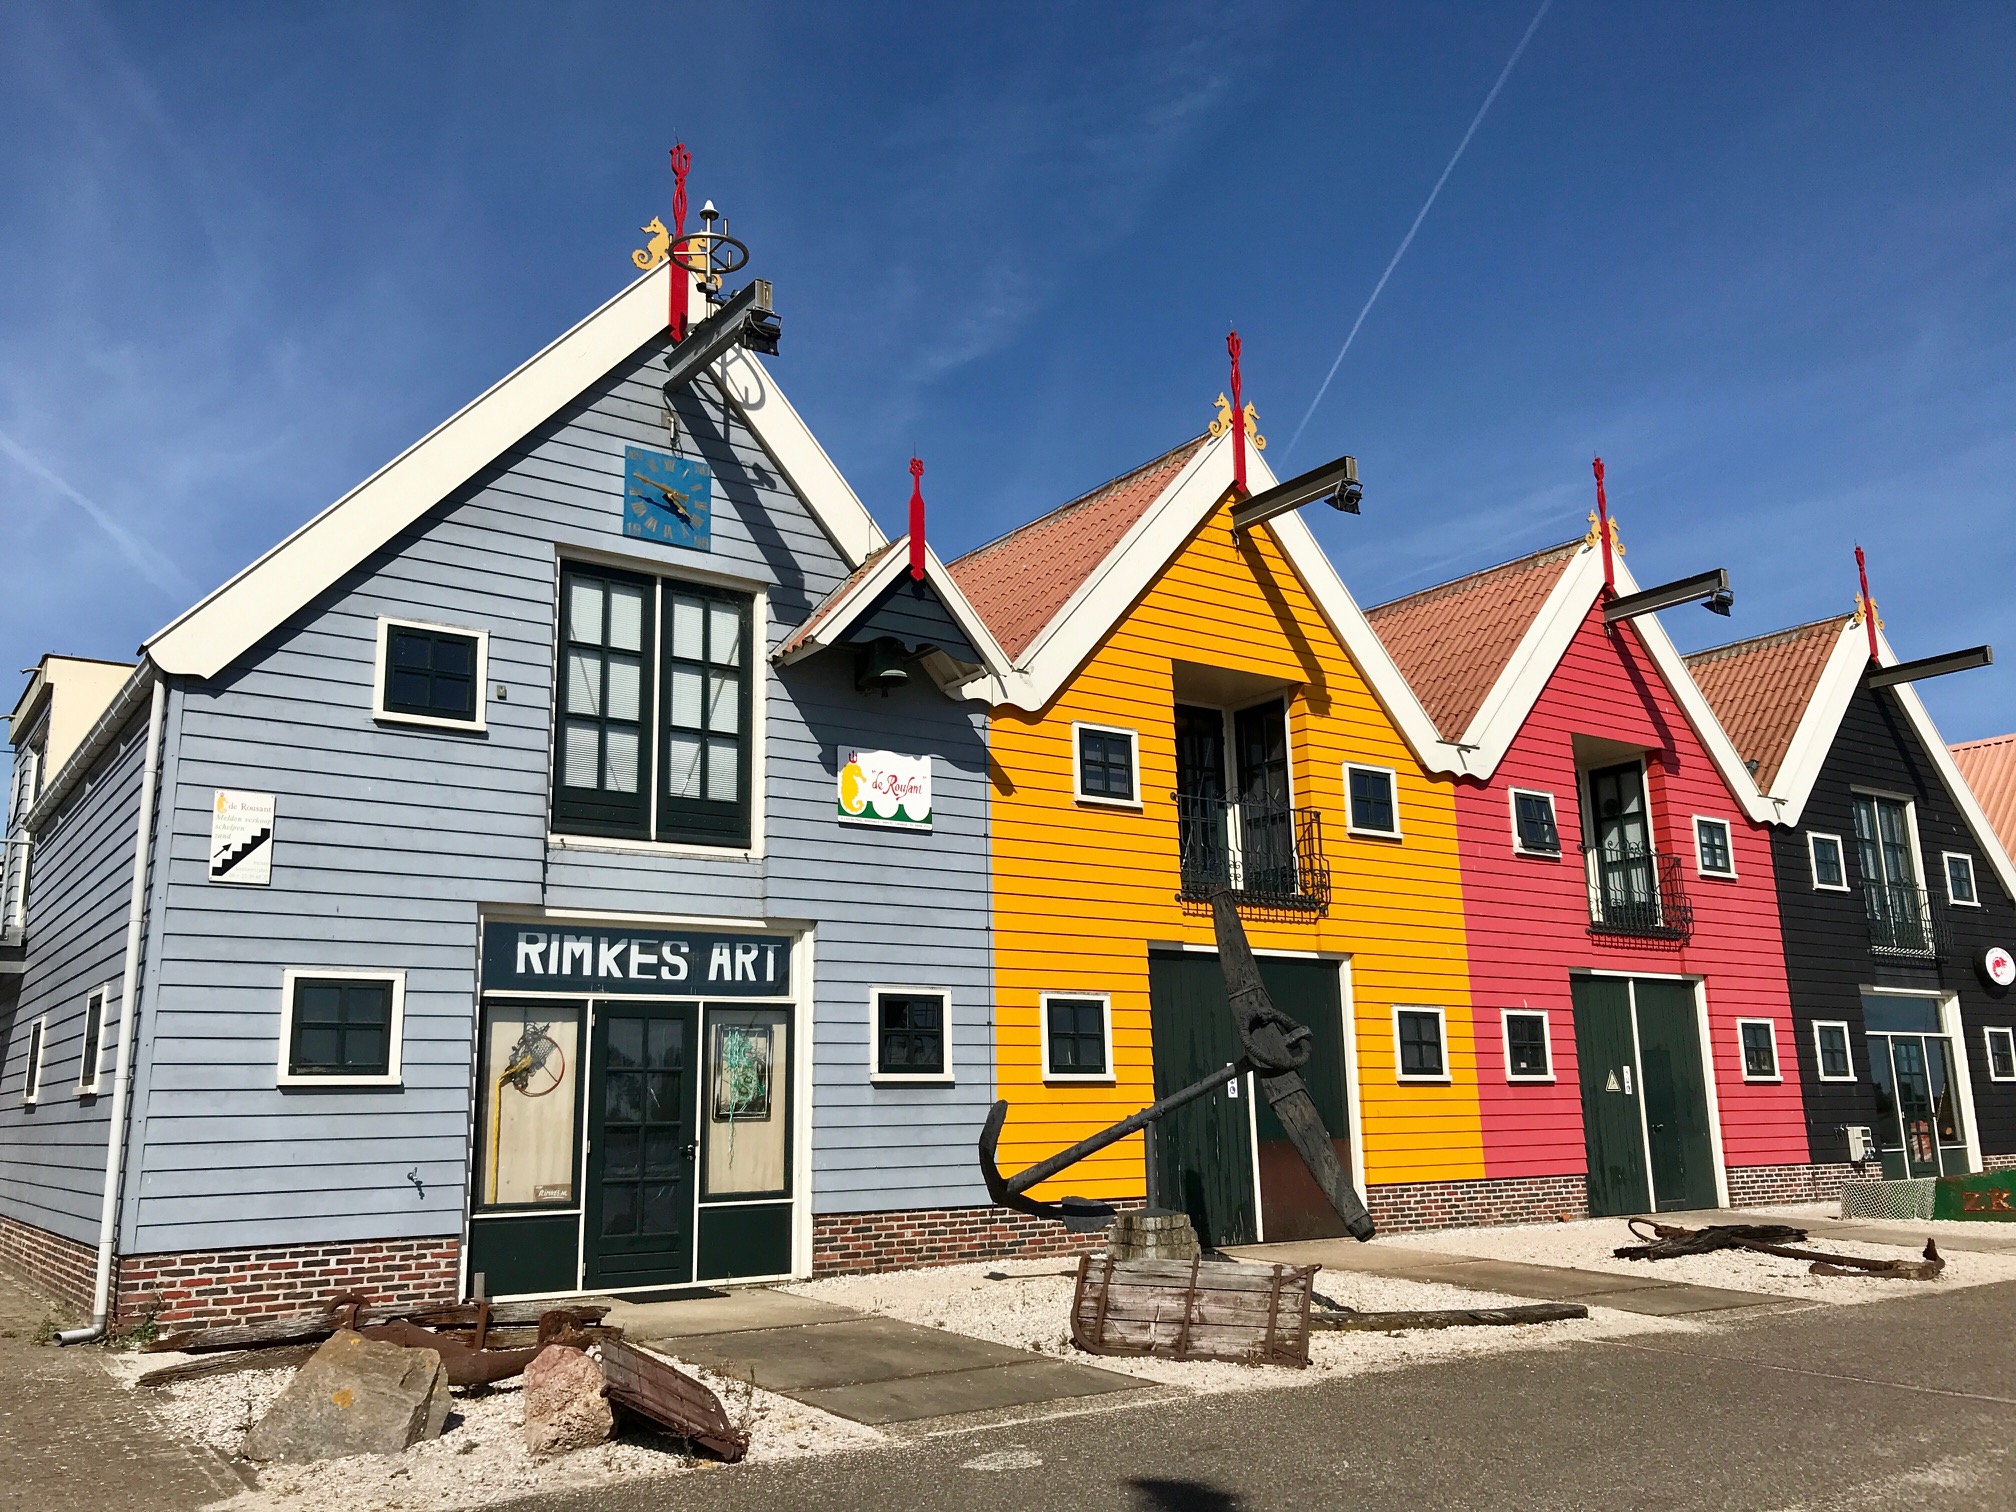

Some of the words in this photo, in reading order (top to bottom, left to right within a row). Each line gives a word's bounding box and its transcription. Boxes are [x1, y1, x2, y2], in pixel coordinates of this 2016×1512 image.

[228, 802, 238, 810] de
[240, 803, 272, 813] Rousant
[516, 931, 690, 980] RIMKES
[708, 942, 782, 982] ART
